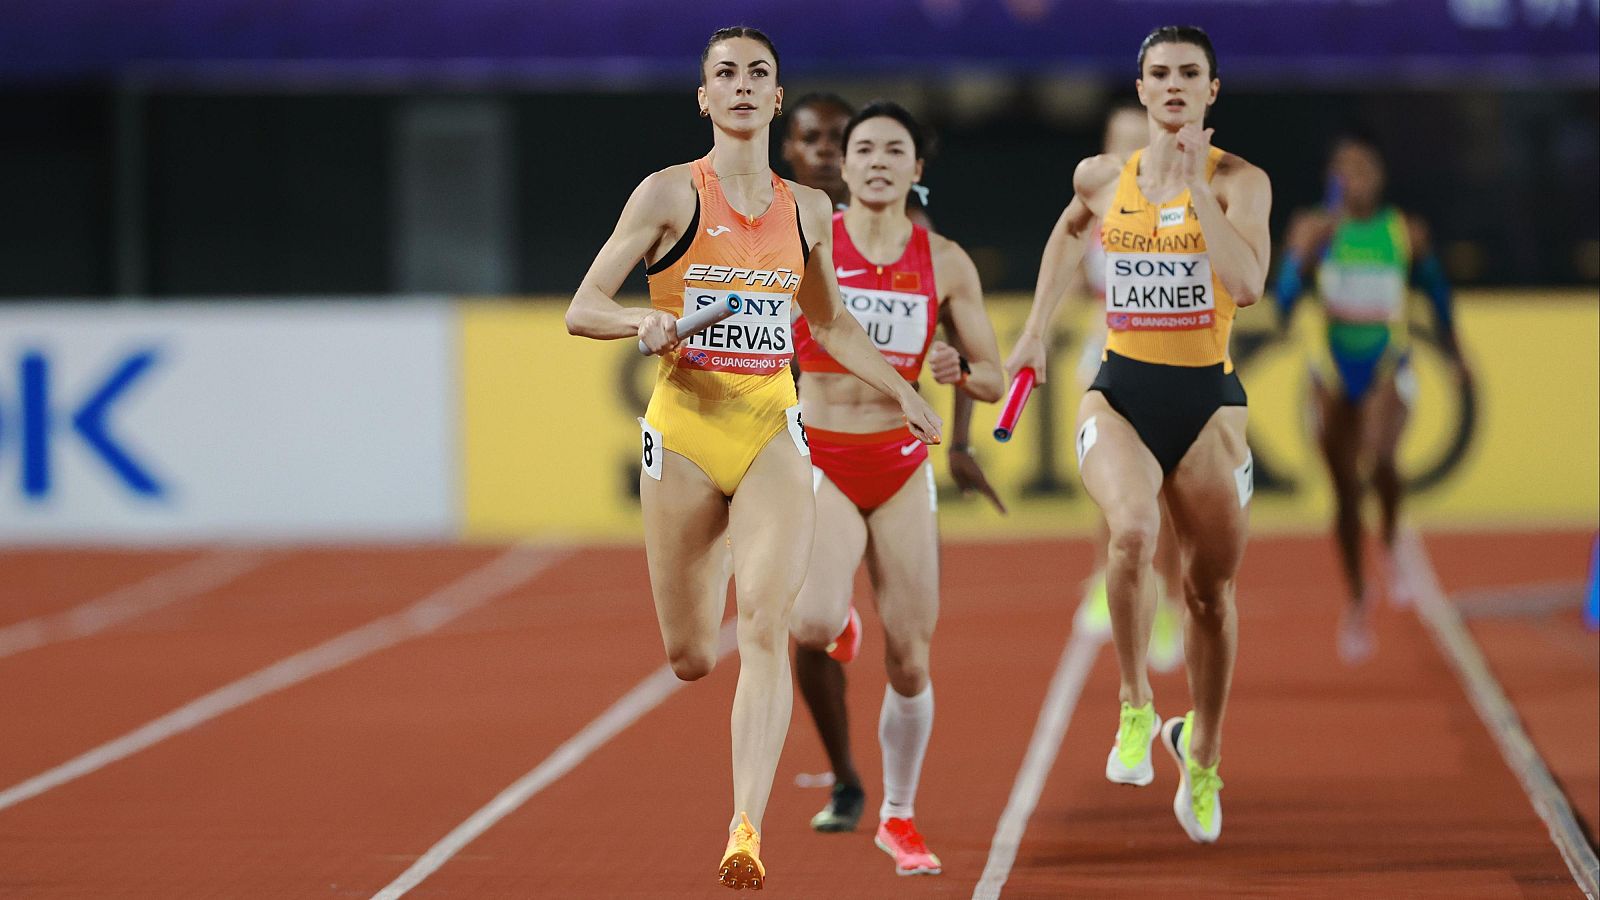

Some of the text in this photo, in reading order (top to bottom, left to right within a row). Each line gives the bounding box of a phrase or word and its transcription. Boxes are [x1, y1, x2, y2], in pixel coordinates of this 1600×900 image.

[1107, 228, 1202, 252] GERMANY
[683, 263, 801, 291] ESPAÑA
[1115, 259, 1200, 277] SONY
[696, 294, 785, 317] SNY
[1112, 284, 1207, 308] LAKNER
[1131, 315, 1211, 328] GUANGZHOU 25
[689, 323, 786, 351] HERVAS
[711, 356, 791, 369] GUANGZHOU 25
[0, 349, 165, 499] K
[643, 431, 654, 468] 8
